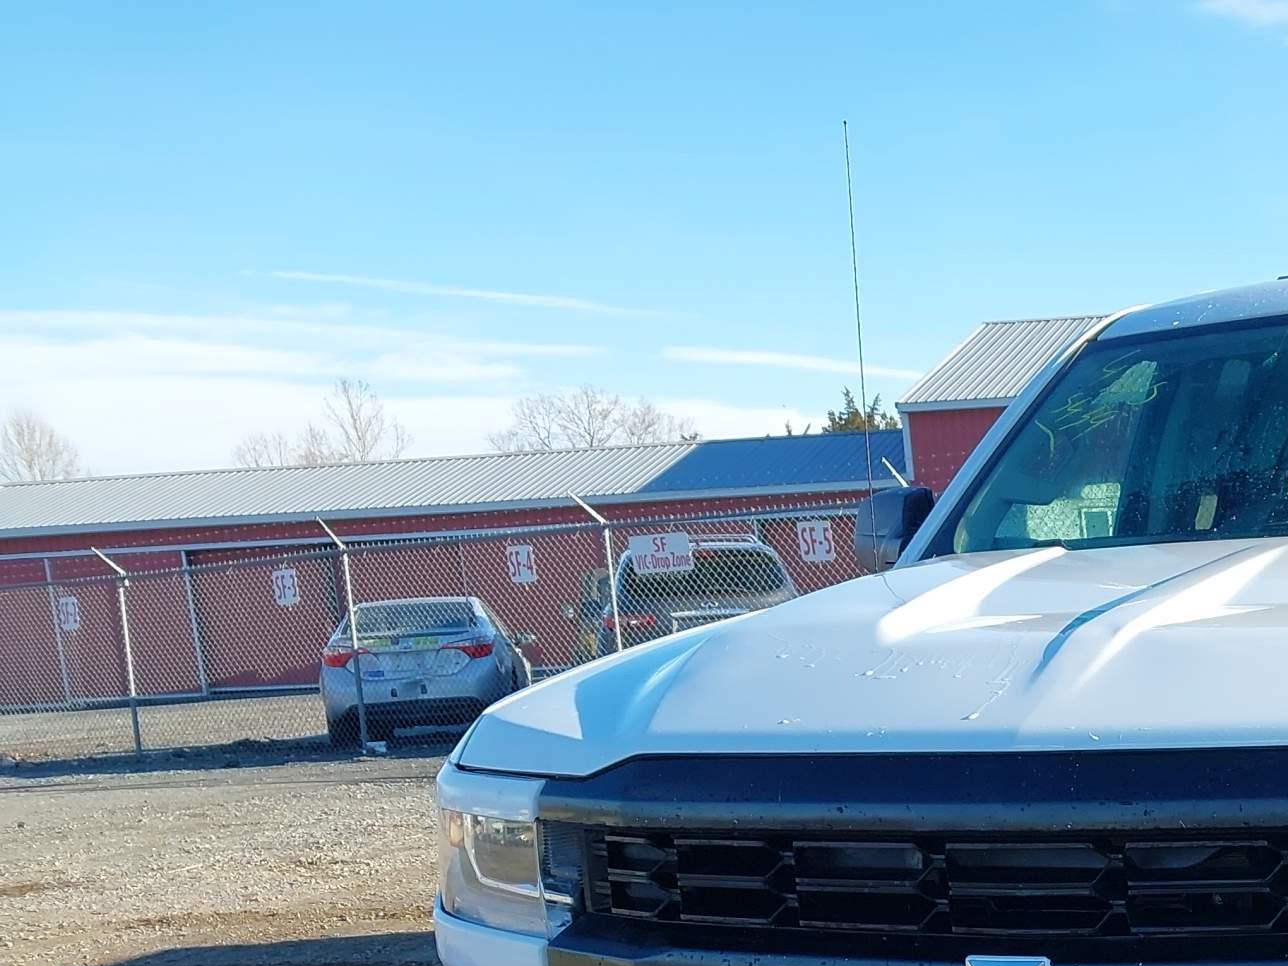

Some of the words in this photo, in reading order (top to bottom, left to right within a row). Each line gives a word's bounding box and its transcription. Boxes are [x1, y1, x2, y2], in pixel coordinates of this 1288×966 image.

[652, 537, 667, 552] SF
[801, 525, 834, 556] SF-5
[507, 546, 534, 581] SF-4
[671, 552, 691, 567] Zone
[275, 575, 298, 600] SF-3
